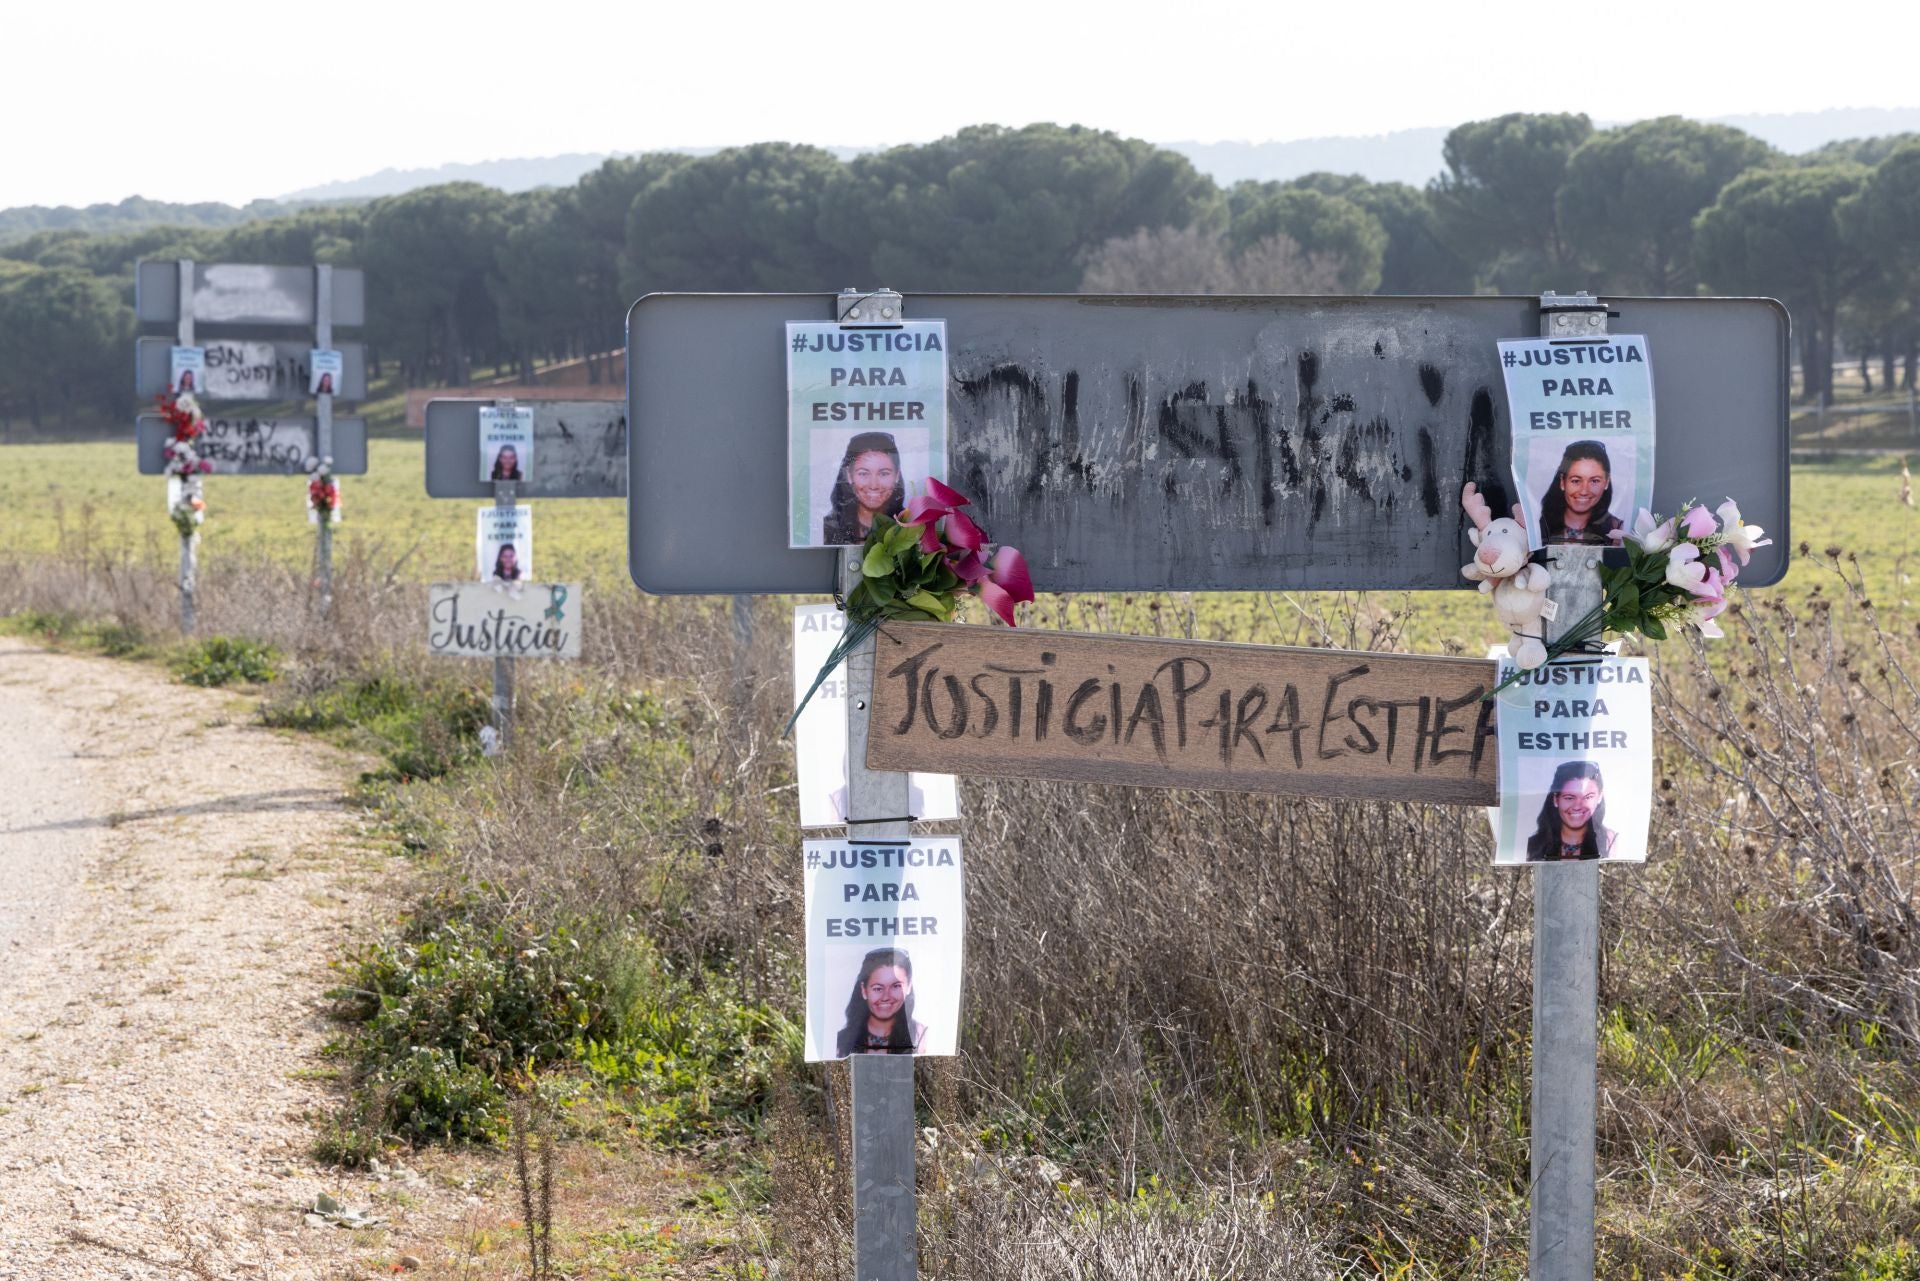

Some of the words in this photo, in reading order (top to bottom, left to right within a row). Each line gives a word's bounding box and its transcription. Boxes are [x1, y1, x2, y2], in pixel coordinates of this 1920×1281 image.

[791, 332, 943, 353] #JUSTICIA
[1502, 345, 1643, 368] #JUSTICIA
[830, 367, 907, 387] PARA
[1542, 377, 1614, 397] PARA
[811, 401, 925, 421] ESTHER
[1529, 410, 1632, 430] ESTHER
[430, 593, 569, 652] Justicia
[1533, 698, 1610, 719] PARA
[1517, 730, 1628, 751] ESTHER
[806, 848, 955, 870] #JUSTICIA
[843, 882, 920, 902] PARA
[826, 916, 939, 938] ESTHER
